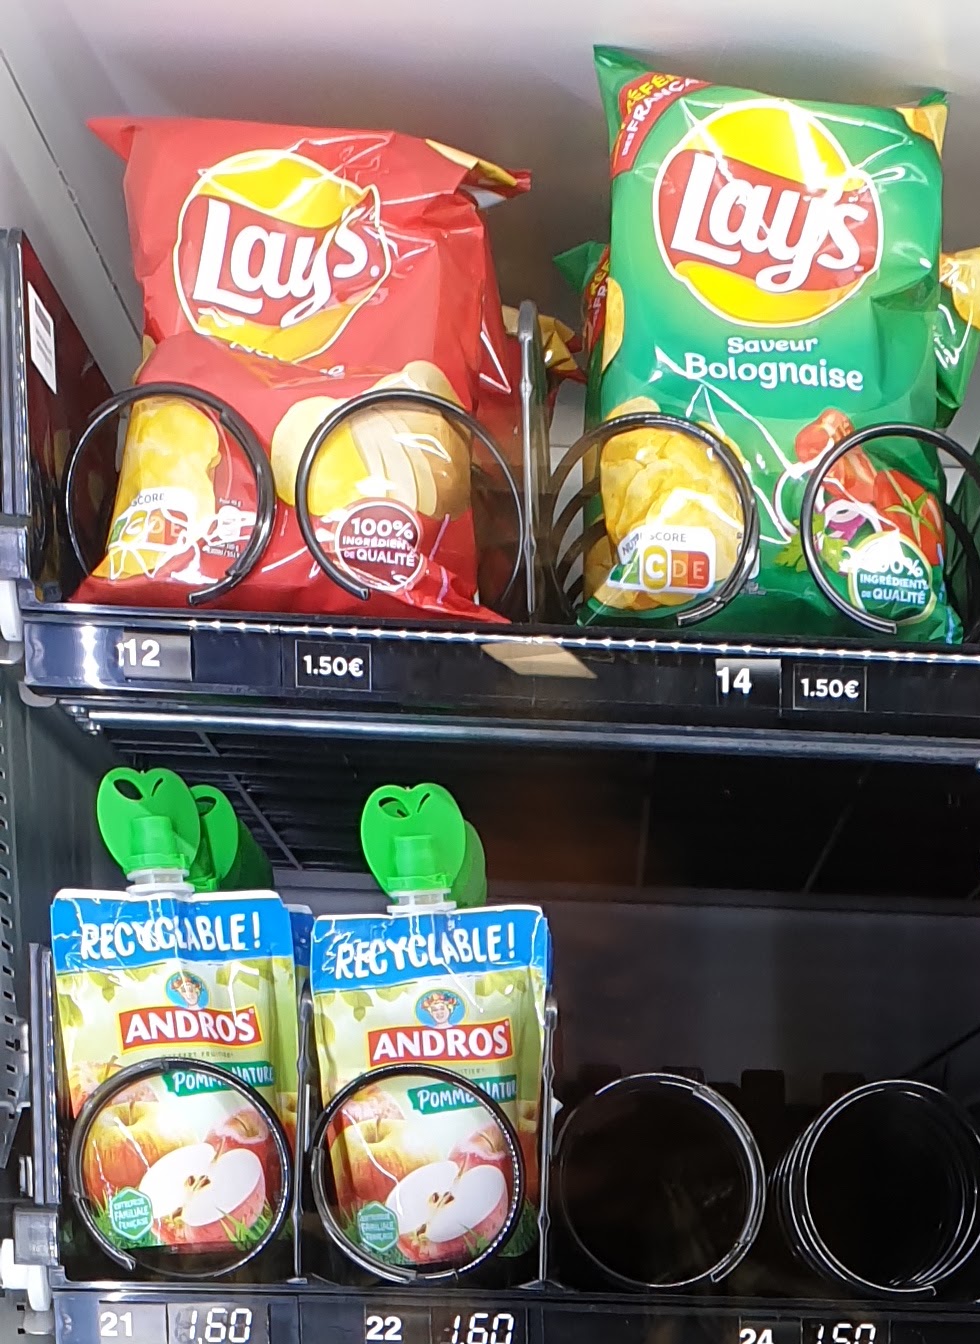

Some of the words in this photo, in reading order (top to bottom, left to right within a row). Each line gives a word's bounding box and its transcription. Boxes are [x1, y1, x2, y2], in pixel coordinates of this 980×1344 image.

[727, 337, 819, 354] Saveur
[685, 352, 865, 391] Bolognaise
[351, 516, 414, 540] 100%
[355, 547, 416, 568] QUALITÉ
[645, 555, 665, 580] C
[672, 557, 688, 579] D
[692, 559, 705, 580] E
[872, 587, 926, 605] QUALITÉ
[303, 654, 364, 680] 1.50€
[716, 667, 753, 695] 14
[800, 678, 860, 700] 1.50€
[124, 1011, 255, 1047] ANDROS
[373, 1023, 509, 1060] ANDROS
[99, 1313, 134, 1338] 21
[366, 1317, 402, 1342] 22
